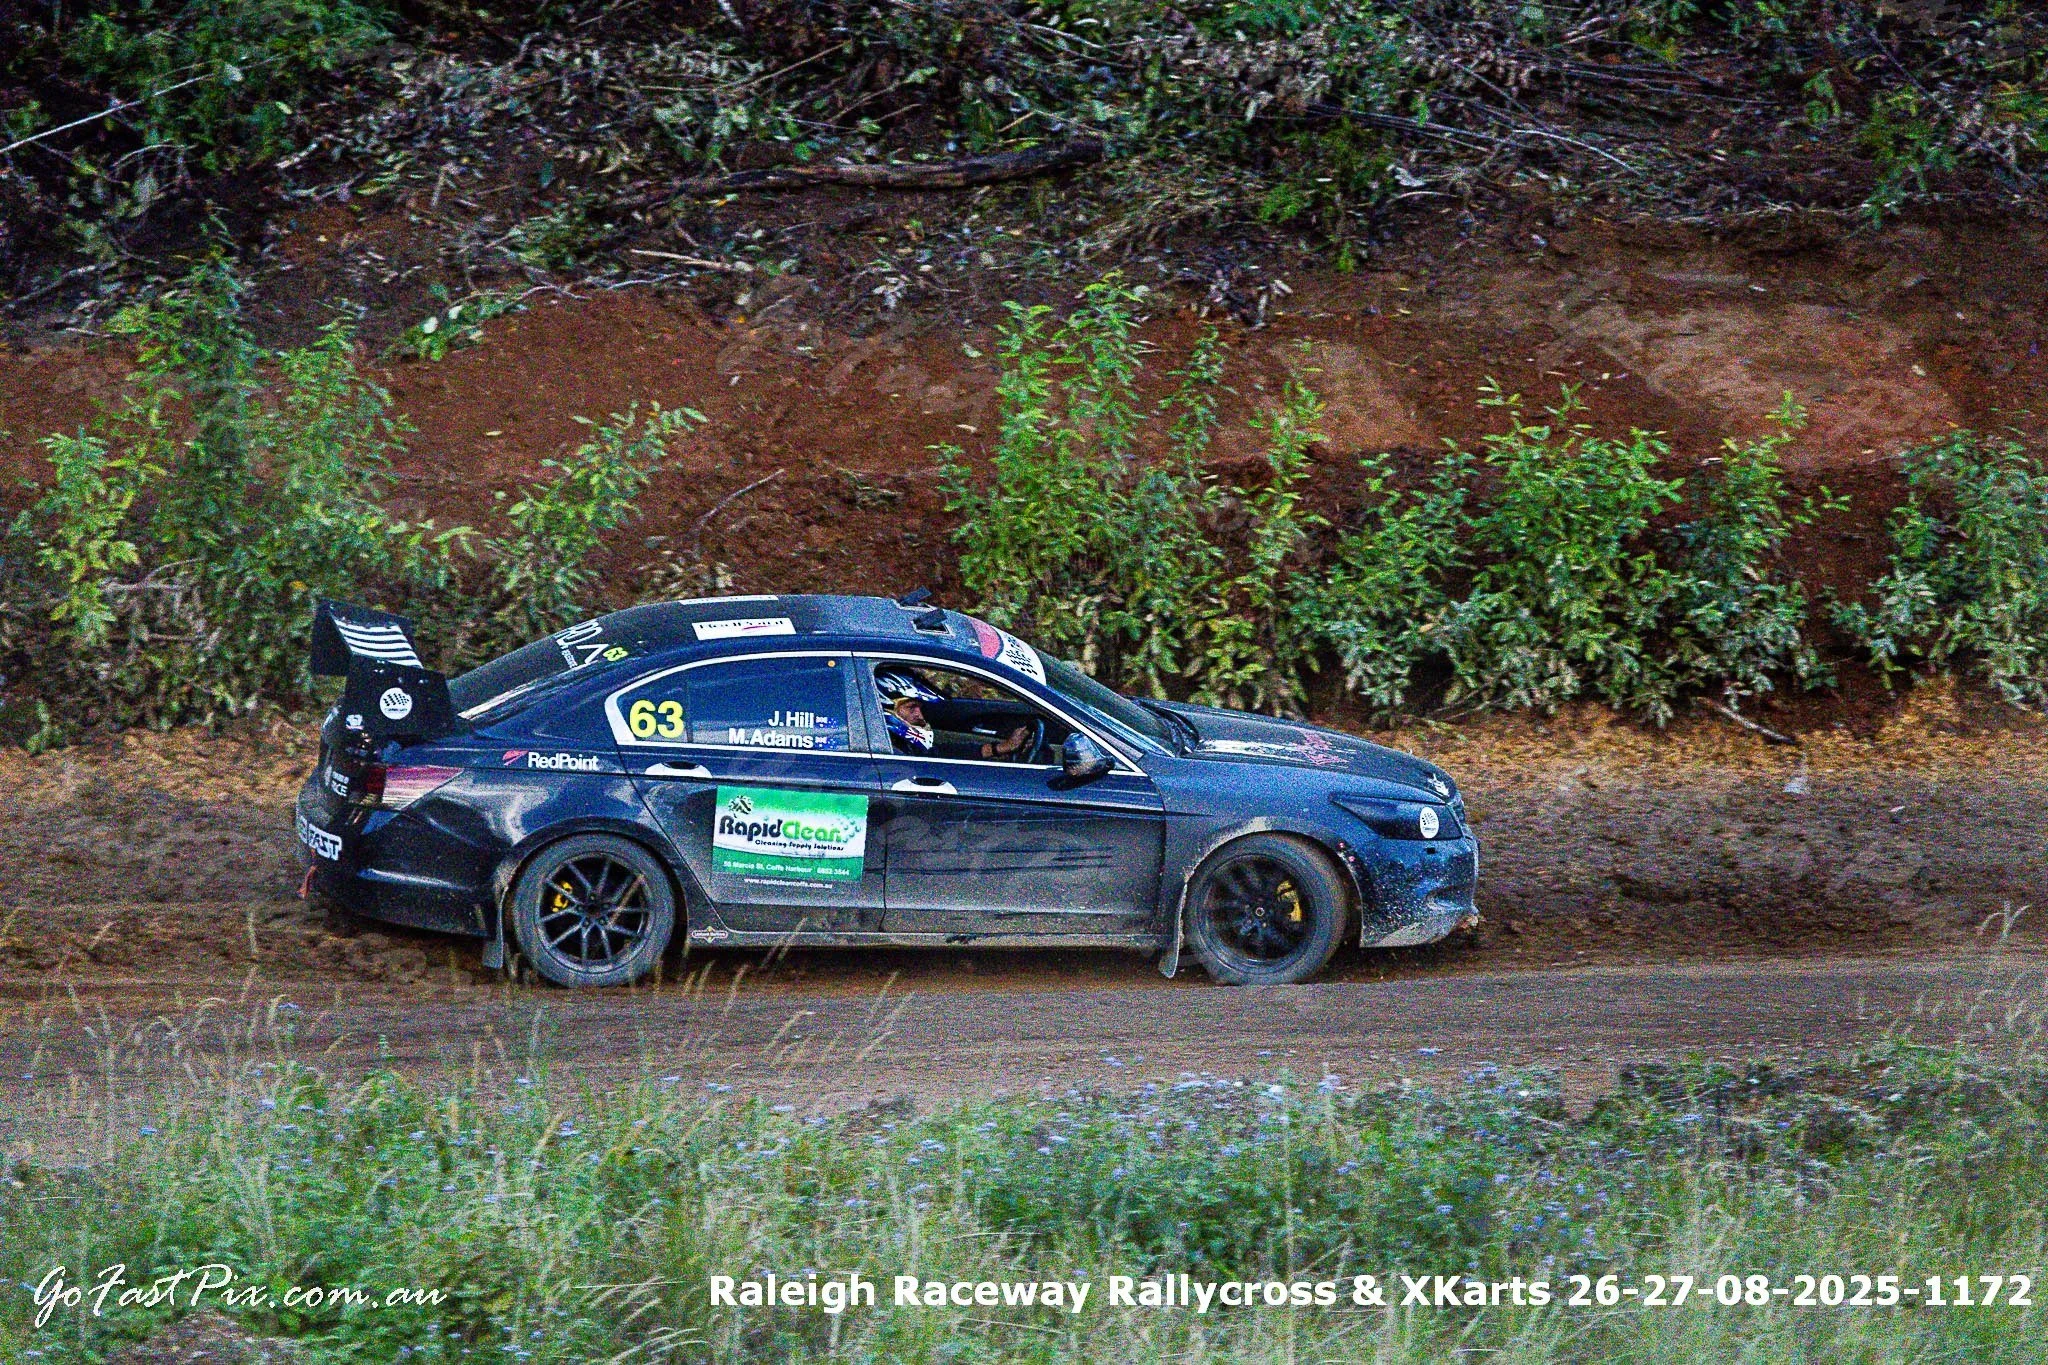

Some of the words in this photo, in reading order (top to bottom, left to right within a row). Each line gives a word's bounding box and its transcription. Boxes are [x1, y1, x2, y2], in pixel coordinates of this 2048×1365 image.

[629, 699, 684, 738] 63
[767, 710, 814, 728] J.Hill
[728, 728, 814, 748] M.Adams
[528, 751, 600, 771] RedPoint
[719, 815, 842, 843] RapidClean
[755, 839, 787, 849] Cleaning
[789, 842, 812, 851] Supply
[814, 843, 844, 851] Solutions
